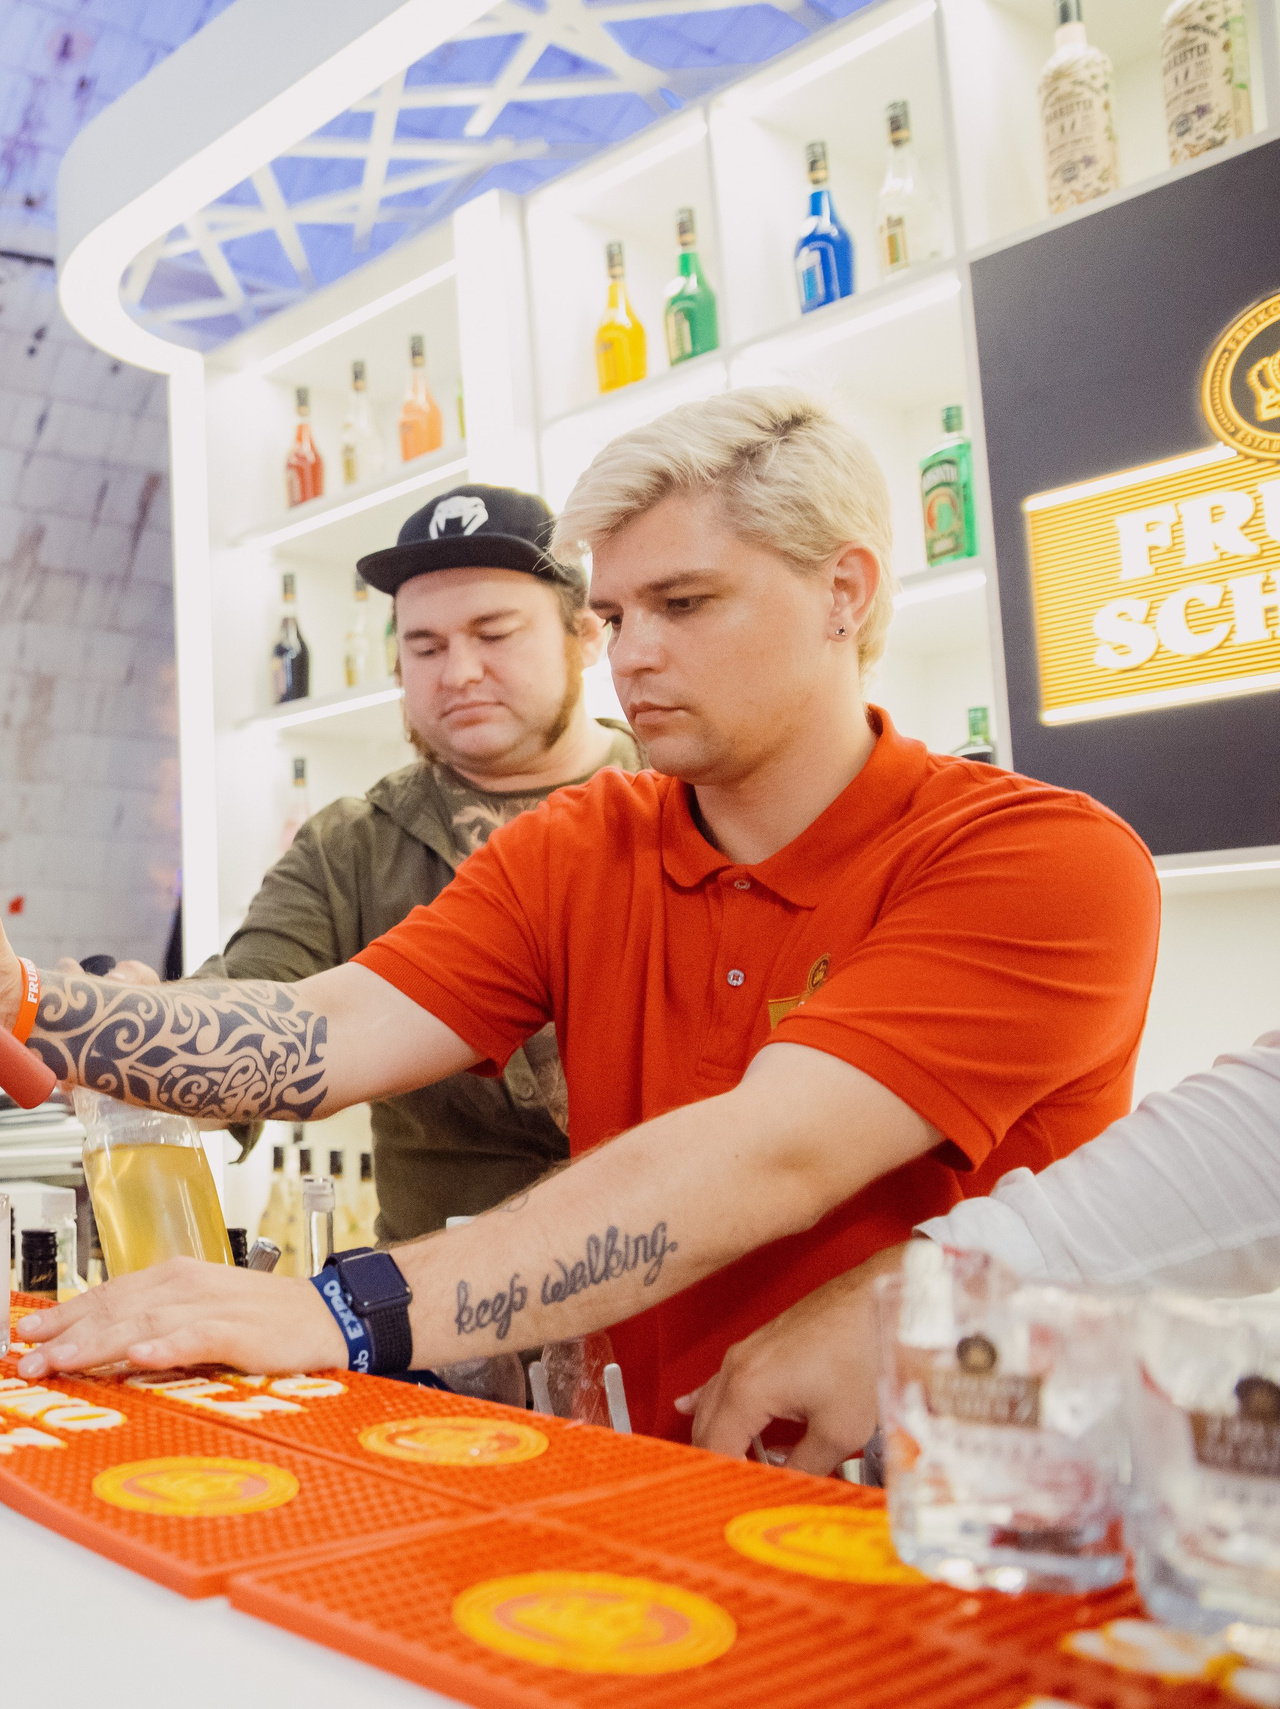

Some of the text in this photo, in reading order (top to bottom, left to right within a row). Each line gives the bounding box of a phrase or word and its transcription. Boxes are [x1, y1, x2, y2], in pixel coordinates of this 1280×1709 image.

[1092, 569, 1280, 672] SCH
[323, 1280, 365, 1340] EXPO
[455, 1273, 528, 1340] keep
